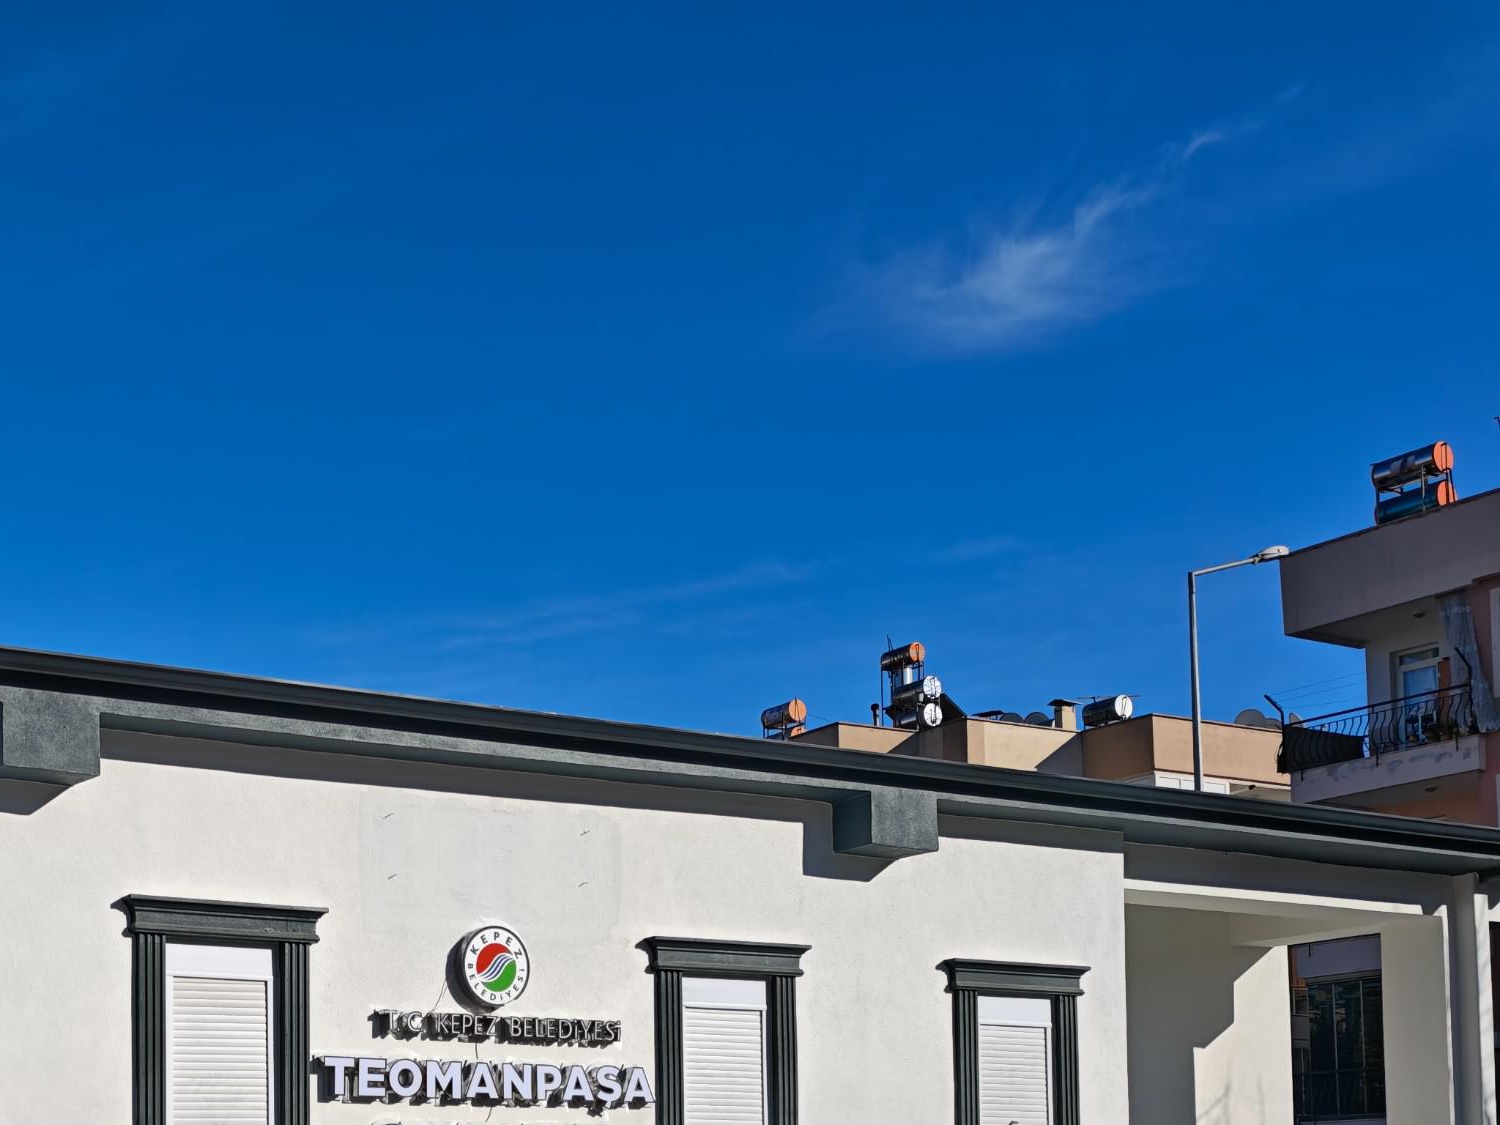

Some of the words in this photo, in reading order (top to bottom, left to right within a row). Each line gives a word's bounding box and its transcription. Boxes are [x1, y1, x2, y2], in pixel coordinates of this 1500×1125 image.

[470, 931, 522, 959] KEPEZ
[436, 1014, 498, 1036] KEPEZ
[324, 1056, 656, 1110] TEOMANPAŞA
